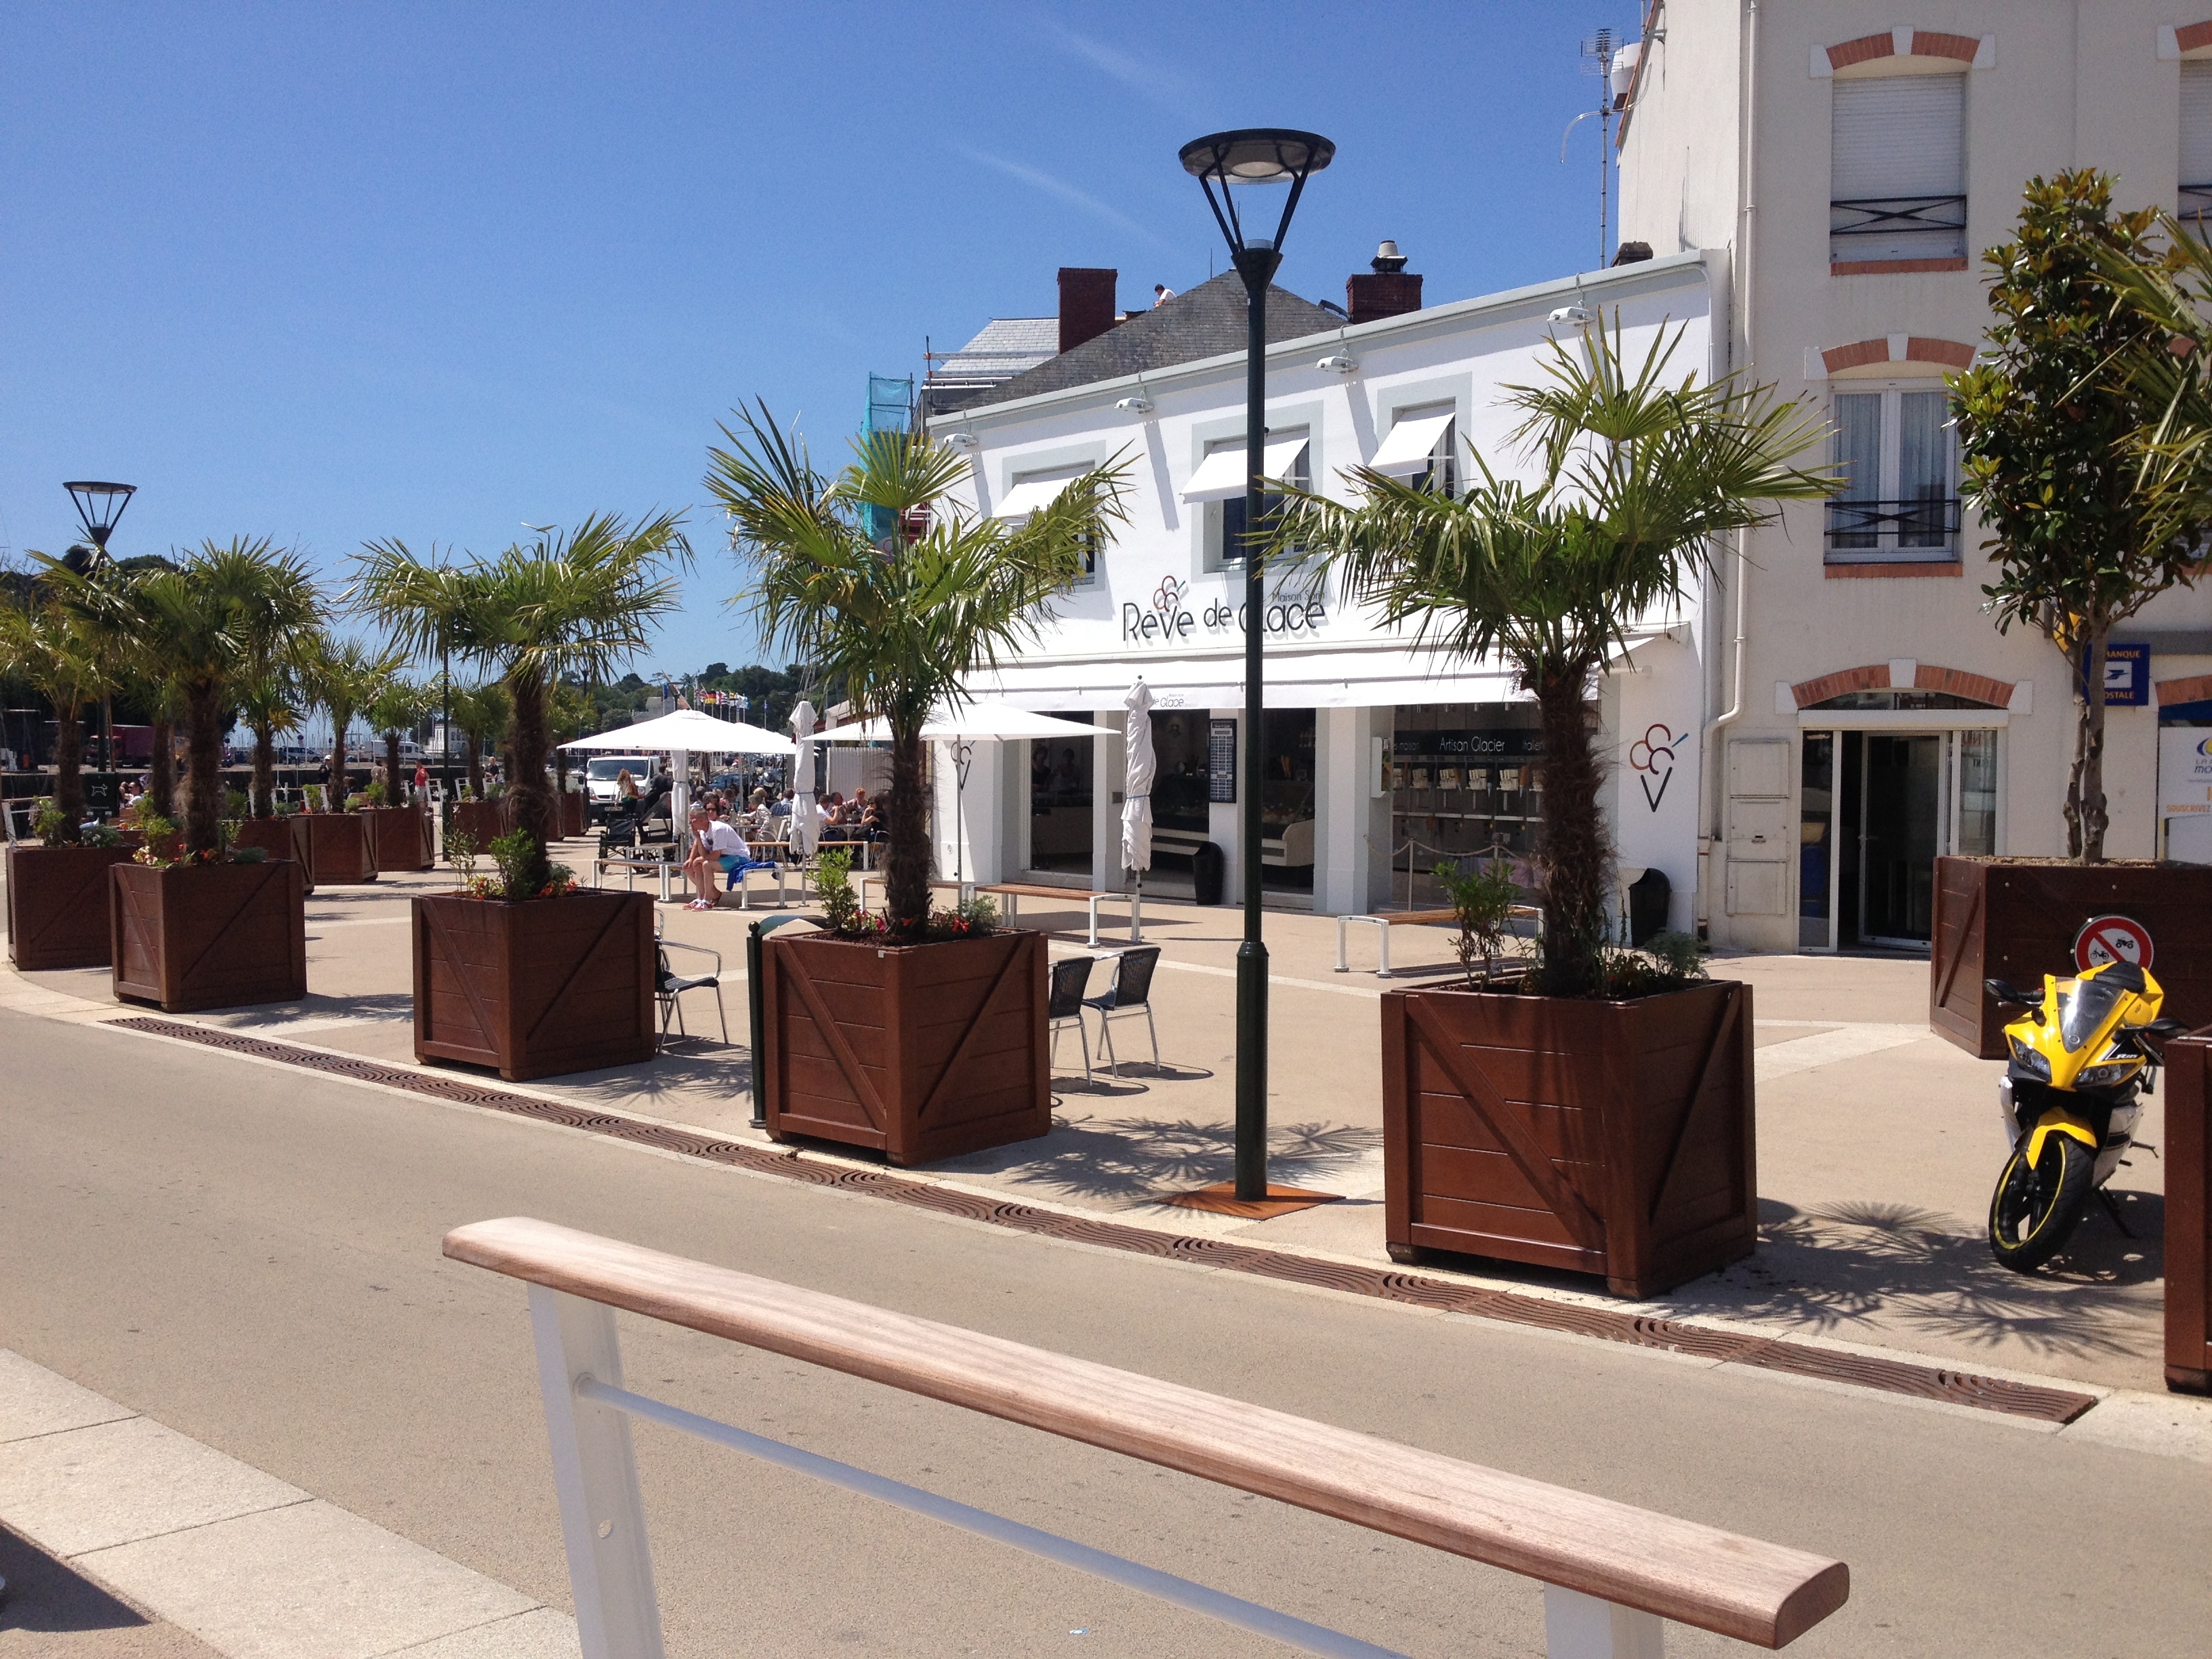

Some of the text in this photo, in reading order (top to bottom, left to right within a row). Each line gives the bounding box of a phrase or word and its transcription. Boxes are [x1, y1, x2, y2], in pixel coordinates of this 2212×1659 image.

[1272, 592, 1302, 602] Maison
[1203, 597, 1232, 628] de
[2105, 691, 2135, 699] OSTALE
[1160, 696, 1184, 708] Glace
[1439, 737, 1469, 752] Artisan
[1471, 736, 1505, 752] Glacier
